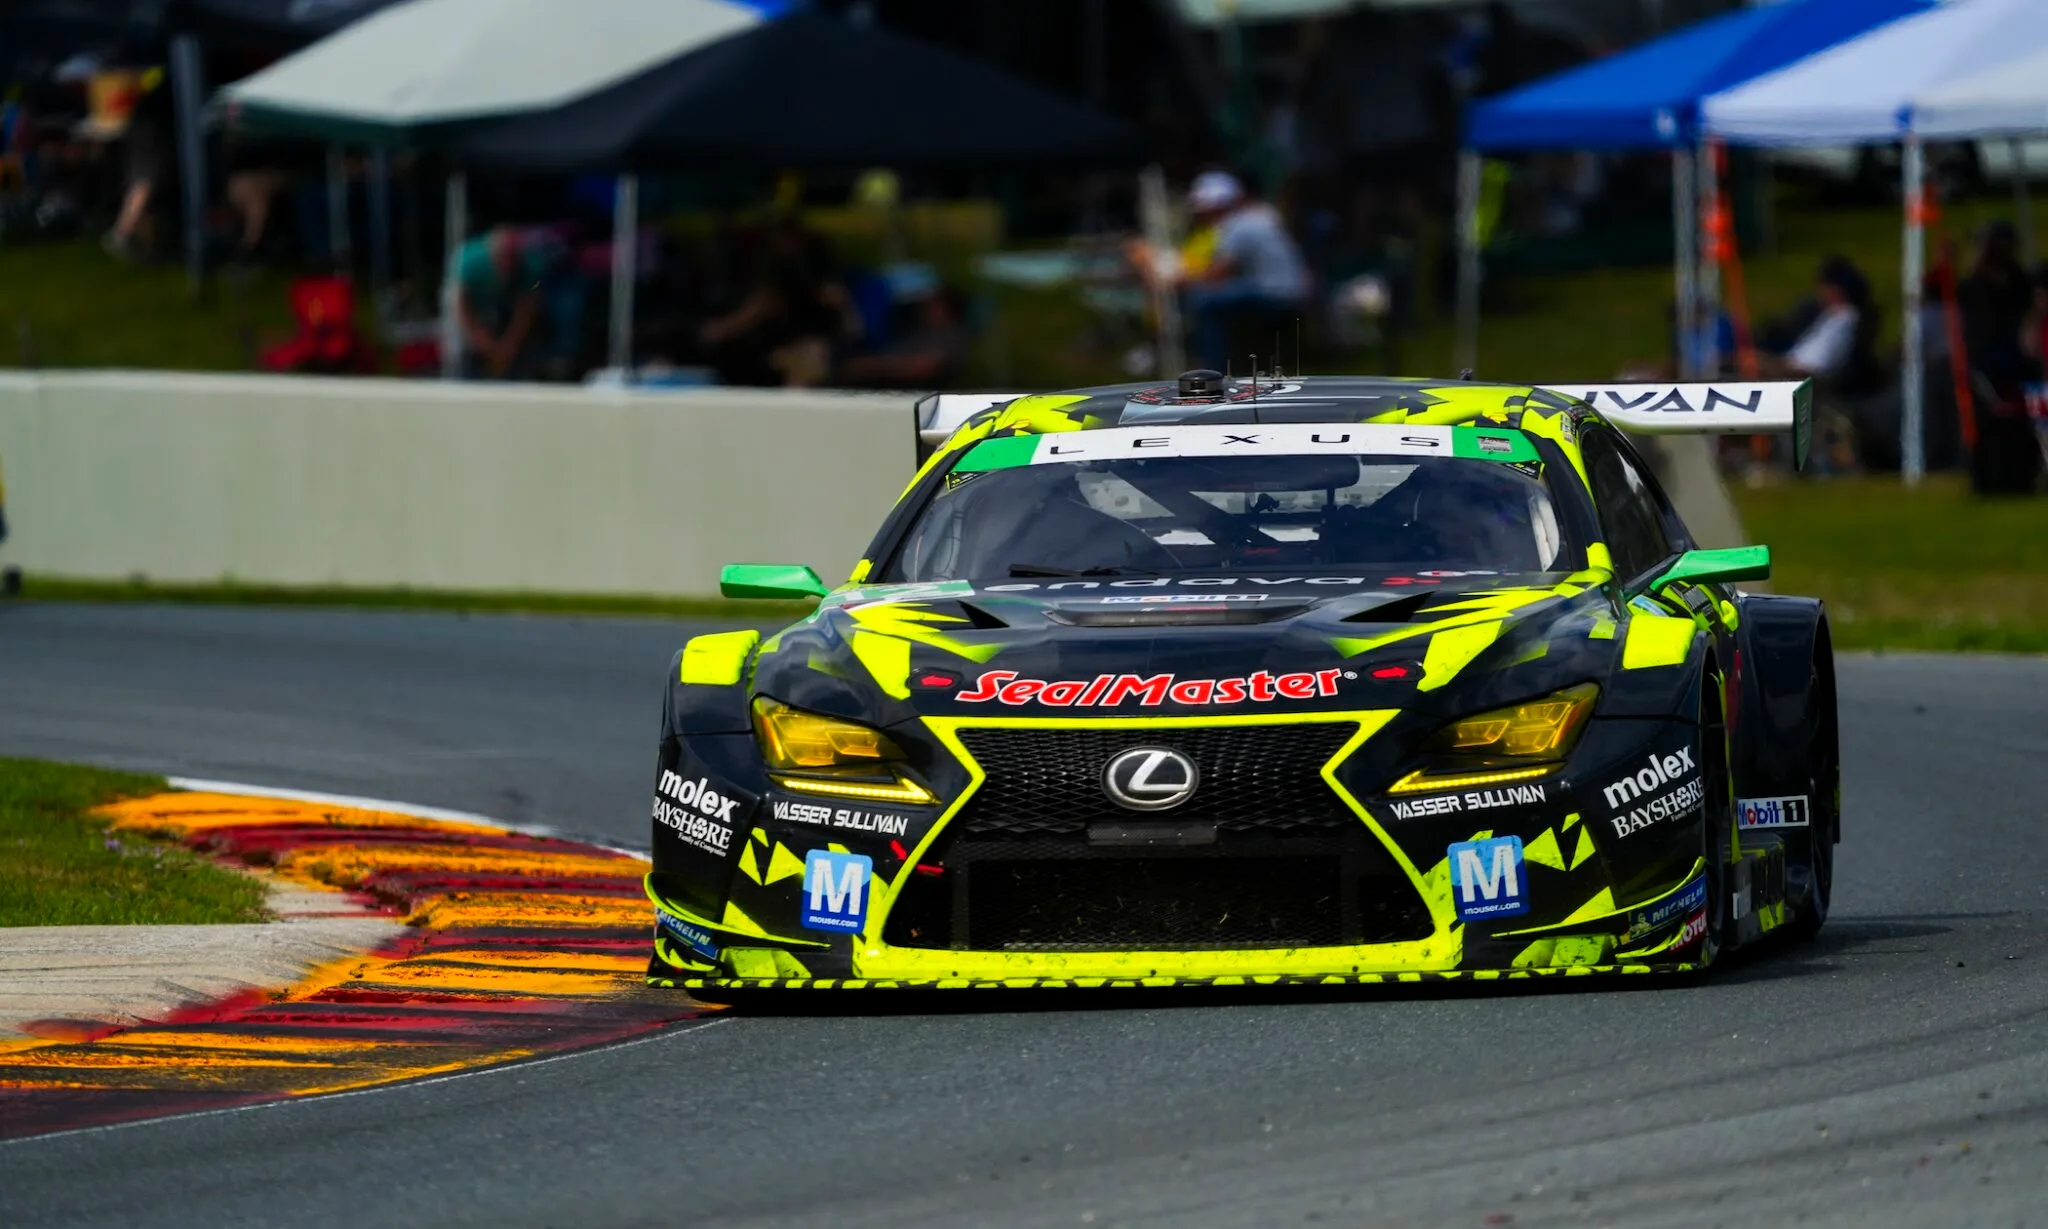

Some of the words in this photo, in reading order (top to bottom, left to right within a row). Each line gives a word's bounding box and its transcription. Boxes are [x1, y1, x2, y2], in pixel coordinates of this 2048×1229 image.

[1050, 434, 1440, 455] LEXUS
[984, 577, 1365, 592] endava
[1603, 746, 1695, 809] molex
[658, 769, 737, 823] molex
[1389, 795, 1462, 820] VASSER
[1465, 785, 1546, 810] SULLIVAN
[1739, 801, 1779, 826] Mobil
[652, 796, 734, 849] BAYSHORE
[774, 801, 832, 825] VASSER
[833, 809, 908, 836] SULLIVAN
[810, 858, 864, 915] M
[1458, 844, 1519, 903] M
[808, 915, 858, 928] mouser.com
[1464, 902, 1520, 915] mouser.com
